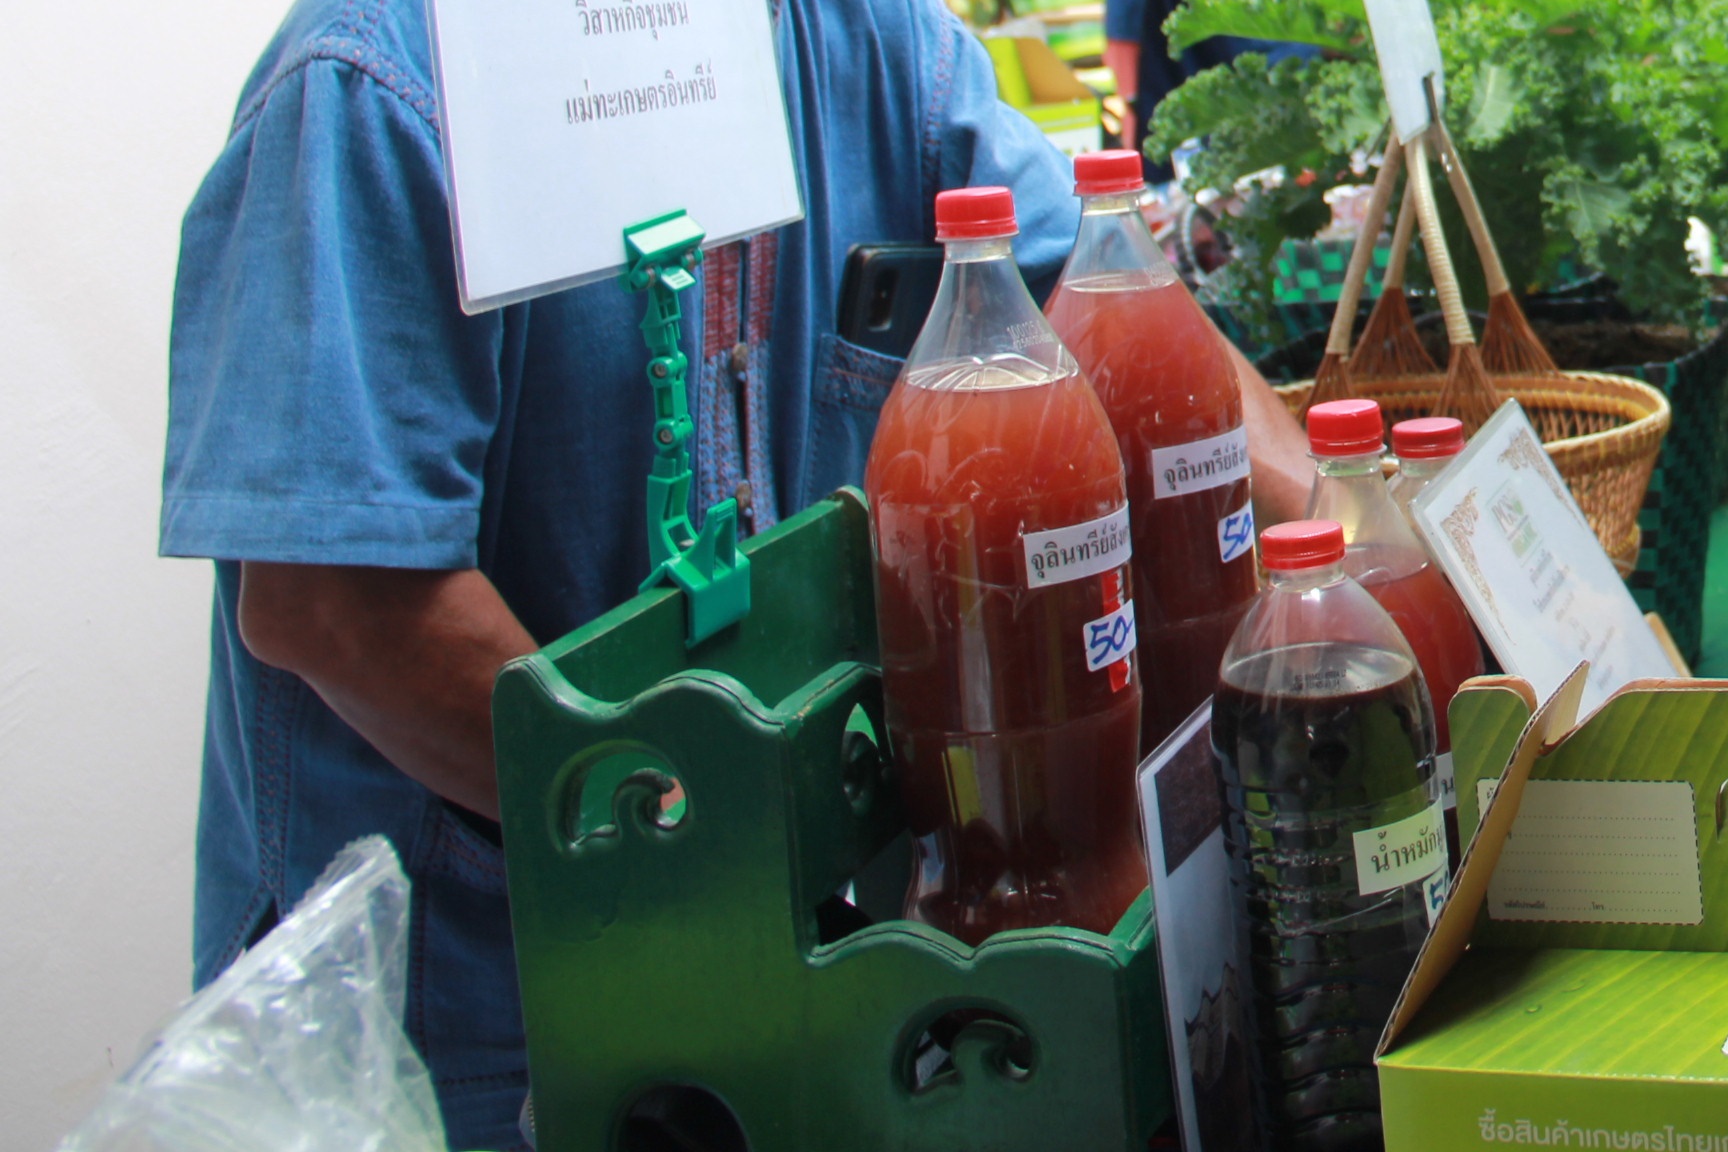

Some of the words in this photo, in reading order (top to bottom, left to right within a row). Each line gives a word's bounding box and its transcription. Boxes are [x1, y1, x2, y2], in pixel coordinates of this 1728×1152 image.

[565, 60, 717, 125] แม่ทะเกษตรอินทรีย์
